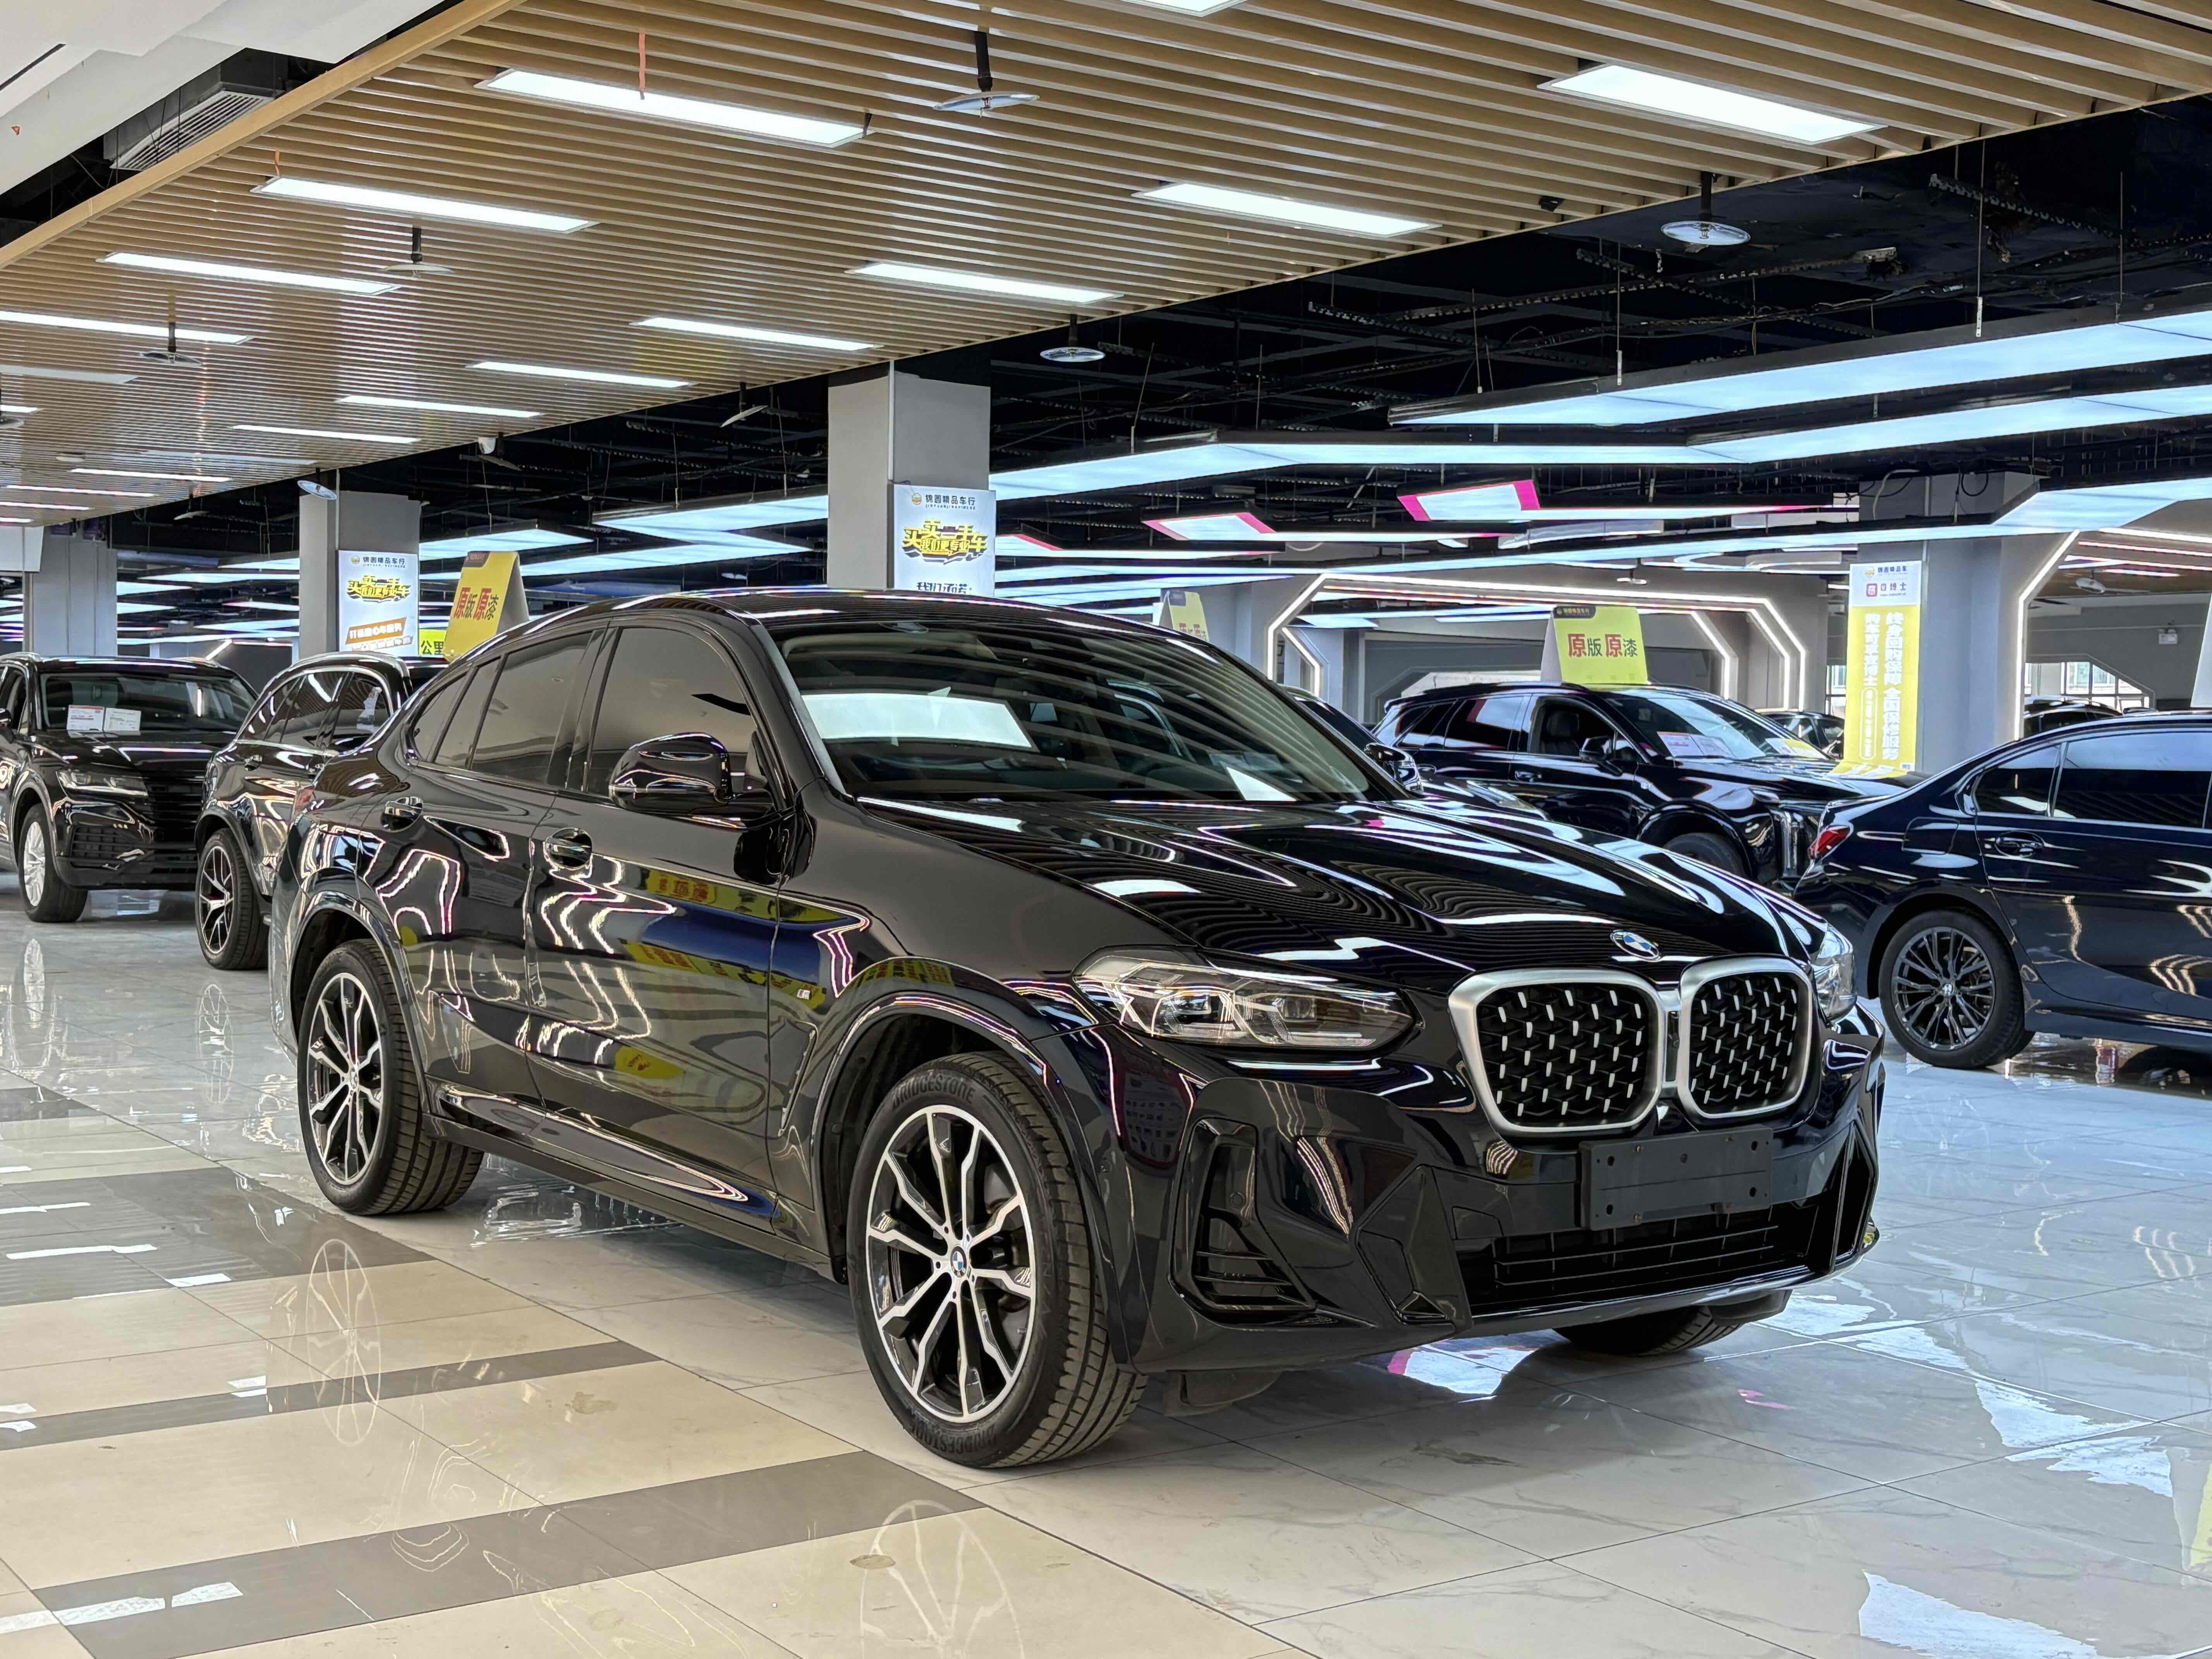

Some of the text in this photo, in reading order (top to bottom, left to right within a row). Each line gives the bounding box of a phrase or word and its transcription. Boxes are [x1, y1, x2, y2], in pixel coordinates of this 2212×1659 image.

[454, 587, 499, 620] 原版原漆
[421, 641, 443, 655] 公里
[1567, 634, 1638, 657] 原版原漆
